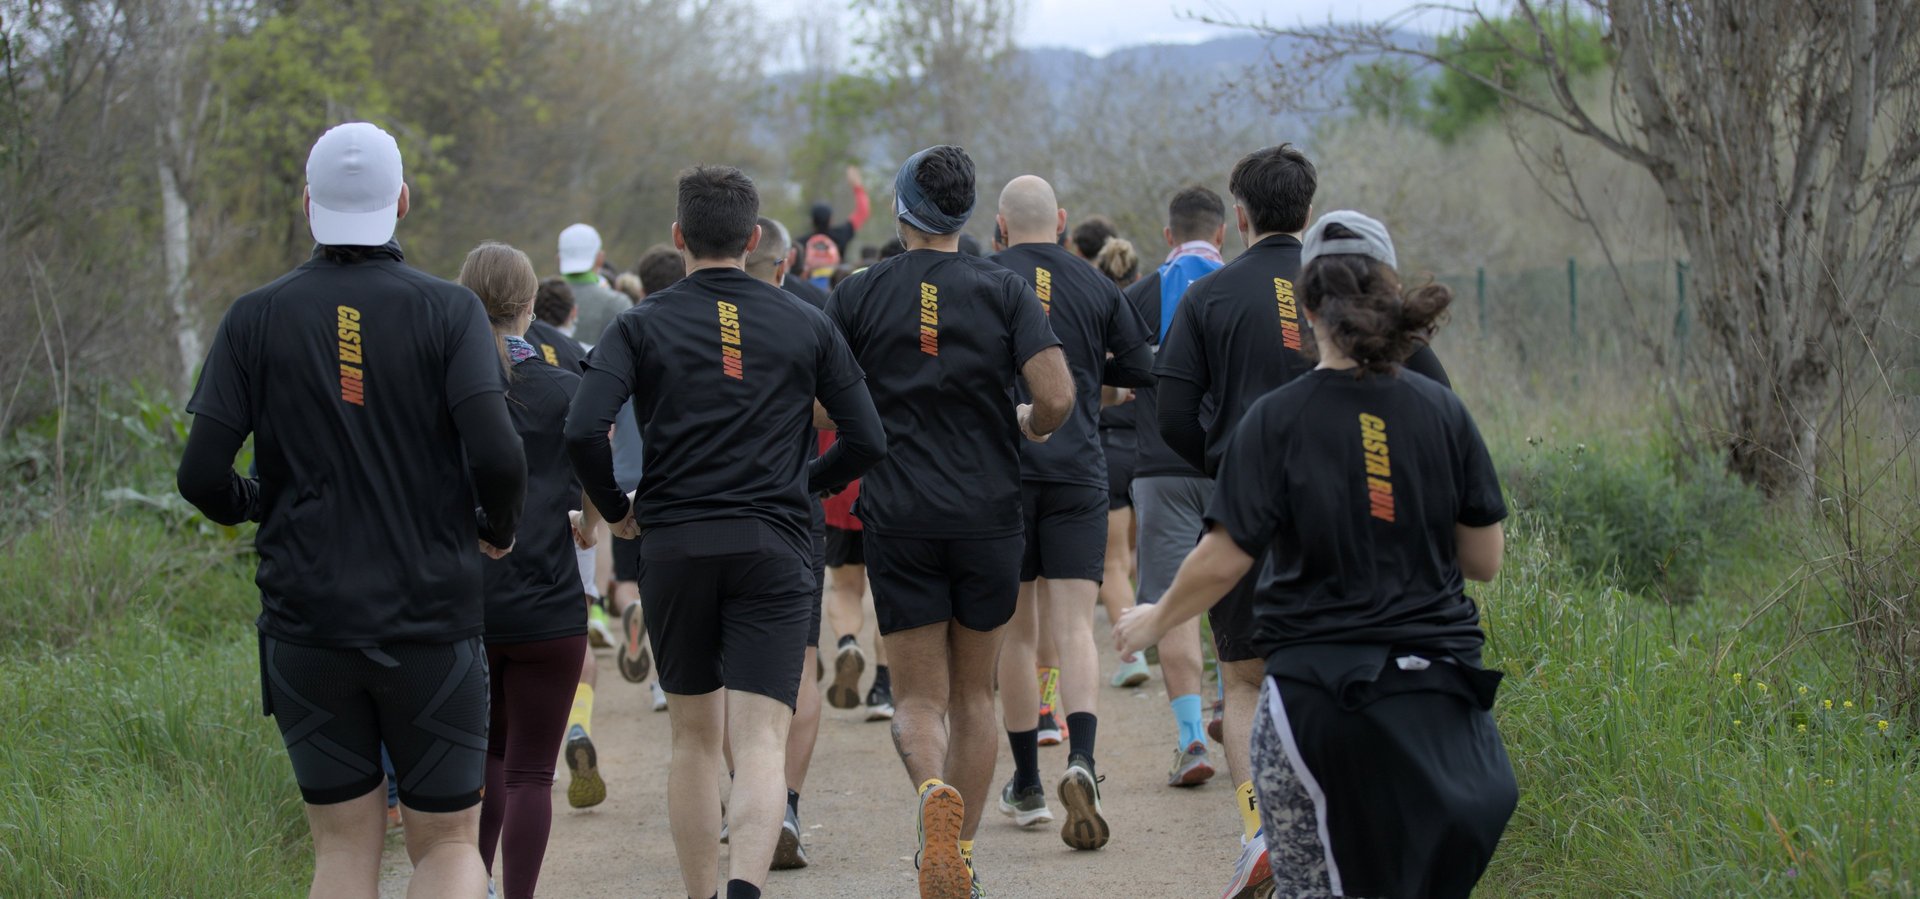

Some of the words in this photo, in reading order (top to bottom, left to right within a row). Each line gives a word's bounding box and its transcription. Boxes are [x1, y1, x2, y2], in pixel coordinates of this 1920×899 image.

[920, 281, 938, 326] CASTA
[1036, 266, 1051, 303] CASTA
[1273, 277, 1298, 319] CASTA
[337, 304, 363, 364] CASTA
[717, 300, 741, 345] CASTA
[920, 324, 938, 356] RUN
[1280, 319, 1302, 352] RUN
[721, 344, 743, 380] RUN
[339, 363, 364, 406] RUN
[1359, 412, 1391, 477] CASTA
[1366, 475, 1395, 522] RUN
